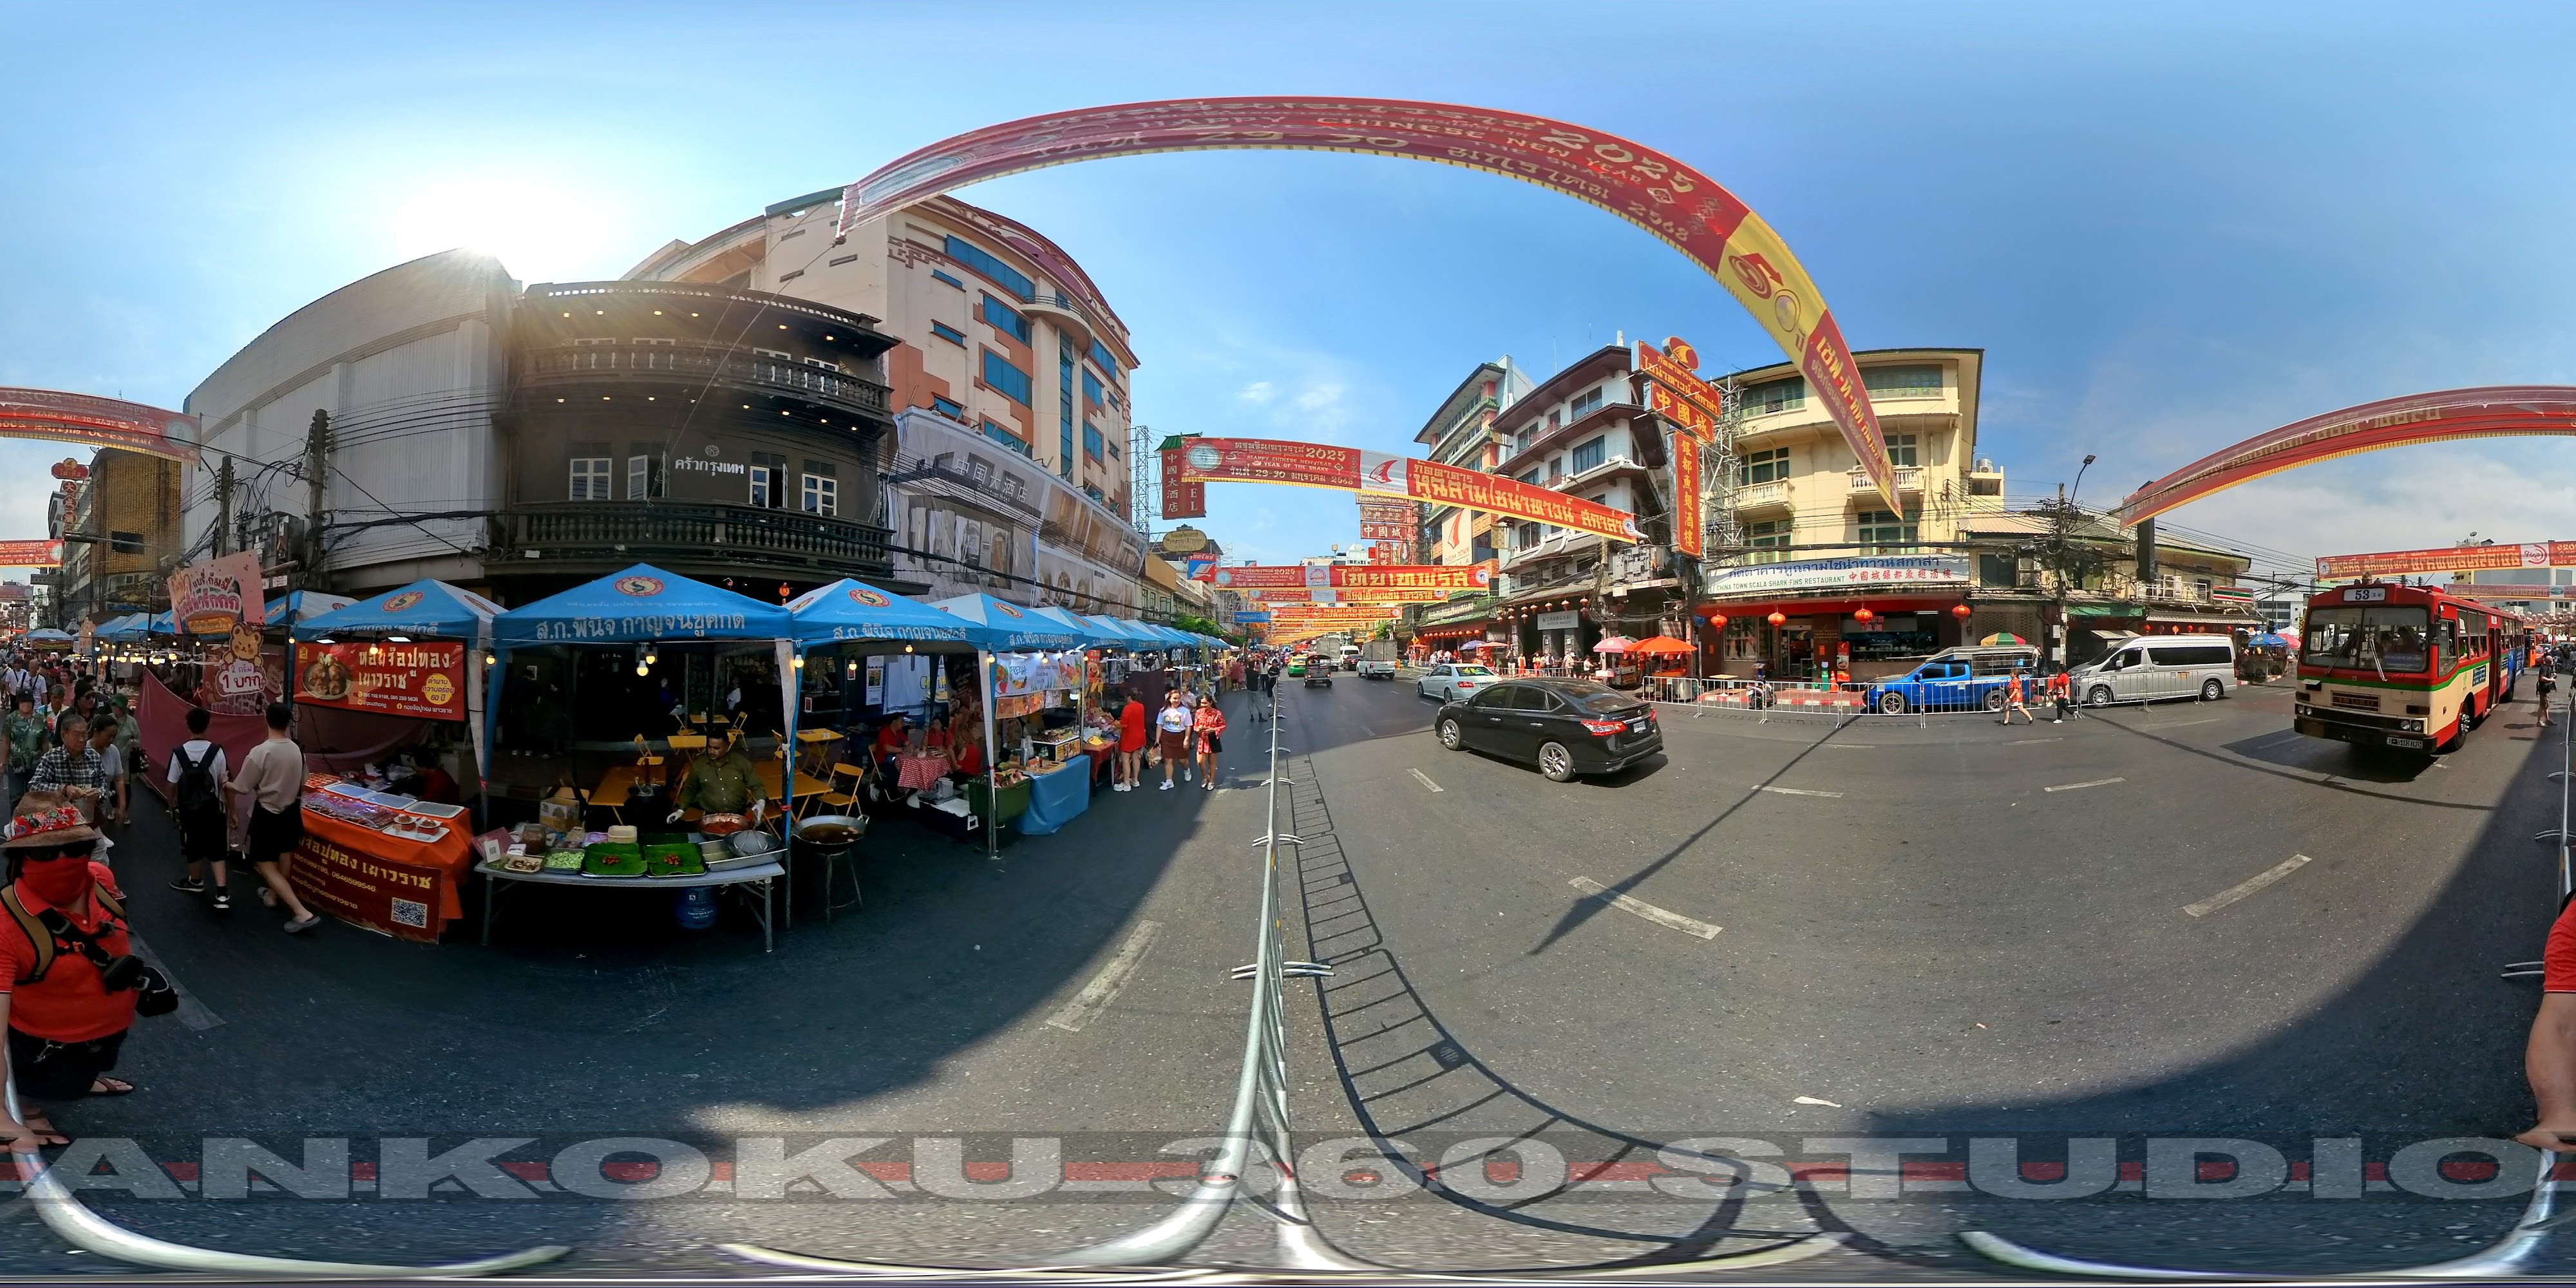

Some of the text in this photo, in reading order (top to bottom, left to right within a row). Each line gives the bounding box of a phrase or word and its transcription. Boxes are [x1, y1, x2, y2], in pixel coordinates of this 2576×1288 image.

[1139, 116, 1287, 128] HAPPY
[1317, 117, 1485, 138] CHINESE
[1506, 137, 1570, 156] NEW
[1586, 158, 1642, 184] YEAR
[1540, 129, 1697, 193] 2025
[1544, 156, 1625, 187] SNAKE
[1195, 131, 1409, 148] 29-30
[1446, 147, 1609, 199] มกราคม
[1627, 200, 1689, 242] 2568
[1656, 390, 1709, 439] 中國城
[1306, 448, 1346, 461] 2025
[675, 457, 744, 477] ครัวกรุงเทพ
[1230, 463, 1354, 485] วันที่ 29-30 มกราคม 2568
[1414, 460, 1473, 483] ภัตตาคาร
[956, 456, 1028, 503] 中国大酒店
[1167, 453, 1179, 513] 中國大酒店
[1681, 440, 1694, 549] 銀都魚翅酒樓
[1363, 524, 1403, 539] 中國城
[1769, 578, 1803, 588] SHARK-FINS
[1804, 576, 1844, 584] RESTAURANT
[1849, 569, 1952, 582] 中國城銀都魚翅酒樓
[2355, 590, 2369, 600] 53
[238, 664, 252, 672] กรัม
[223, 675, 261, 688] 1 บาท
[359, 671, 407, 689] เยาวราช
[422, 685, 455, 694] ความอร่อย
[440, 693, 446, 701] ปี
[332, 871, 377, 893] 0646599546
[363, 862, 433, 889] เยาวราช
